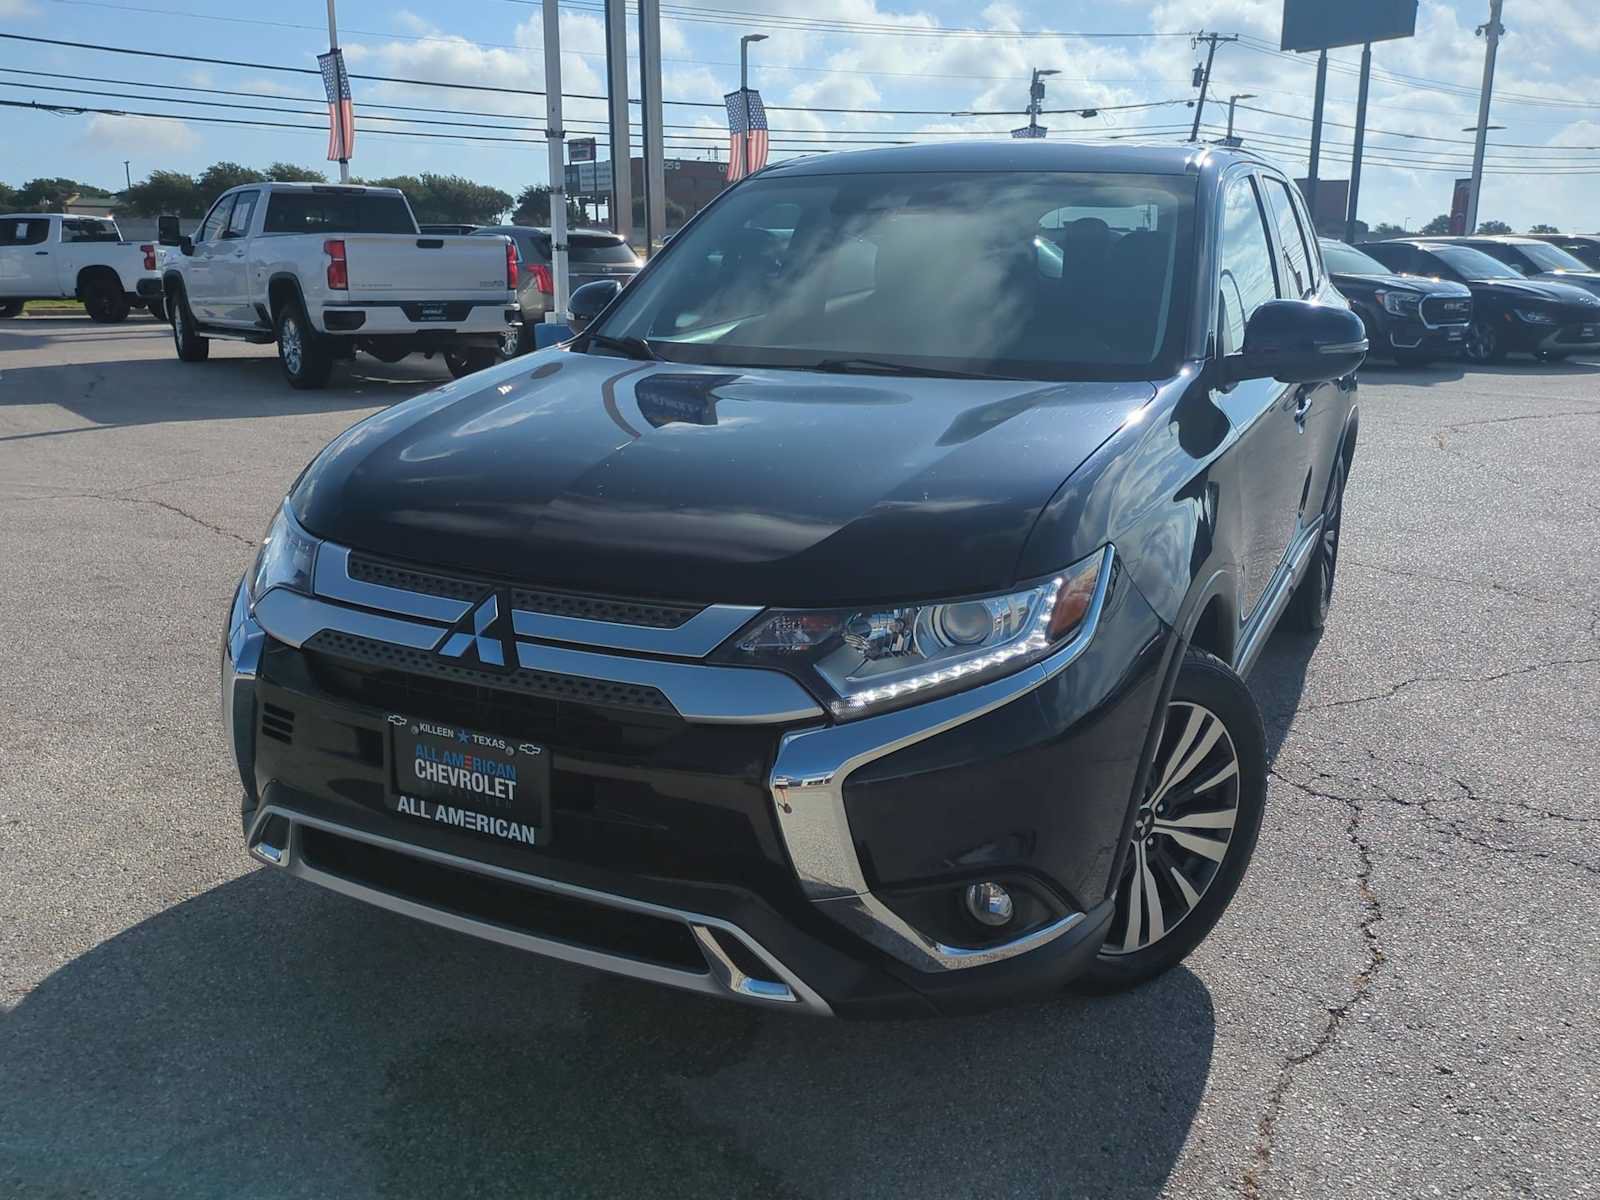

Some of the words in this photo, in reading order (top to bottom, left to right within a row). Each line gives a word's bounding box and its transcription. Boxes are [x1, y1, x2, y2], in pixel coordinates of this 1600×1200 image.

[419, 723, 454, 738] KILLEEN
[472, 734, 506, 750] TEXAS
[414, 758, 517, 801] CHEVROLET
[415, 743, 440, 762] ALL
[443, 751, 518, 780] AMERICAN
[397, 796, 432, 819] ALL
[435, 805, 536, 845] AMERICAN
